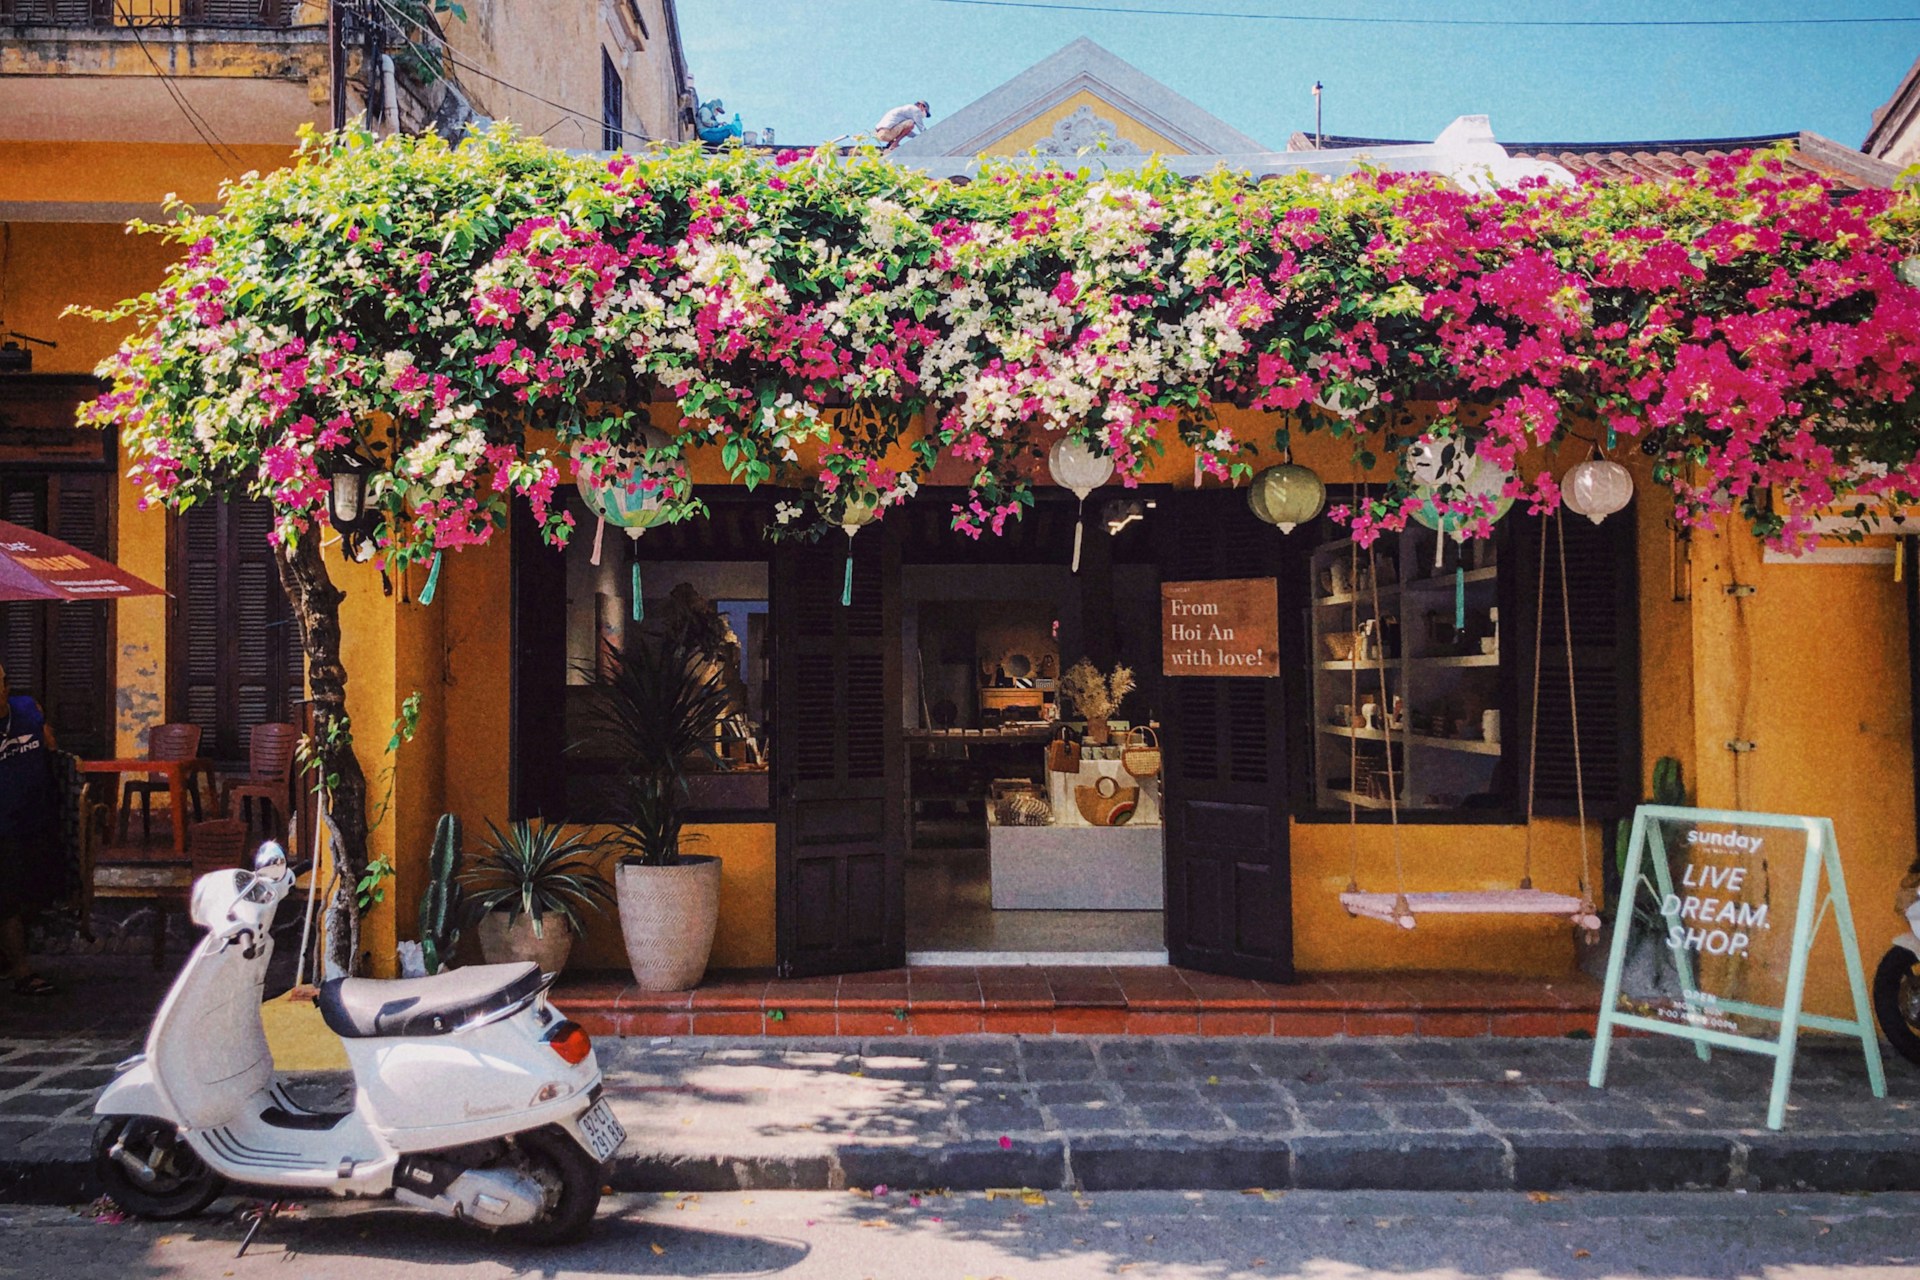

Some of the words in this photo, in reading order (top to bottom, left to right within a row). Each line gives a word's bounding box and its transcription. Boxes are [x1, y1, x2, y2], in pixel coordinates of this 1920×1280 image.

[1171, 599, 1219, 616] From
[1171, 623, 1201, 641] Hoi
[1208, 623, 1234, 641] An
[1172, 649, 1212, 666] with
[1218, 648, 1264, 666] love!
[1687, 830, 1763, 853] sunday
[1682, 863, 1747, 891] LIVE
[1661, 894, 1770, 929] DREAM.
[1666, 925, 1748, 958] SHOP.
[1682, 989, 1717, 1004] OPEN
